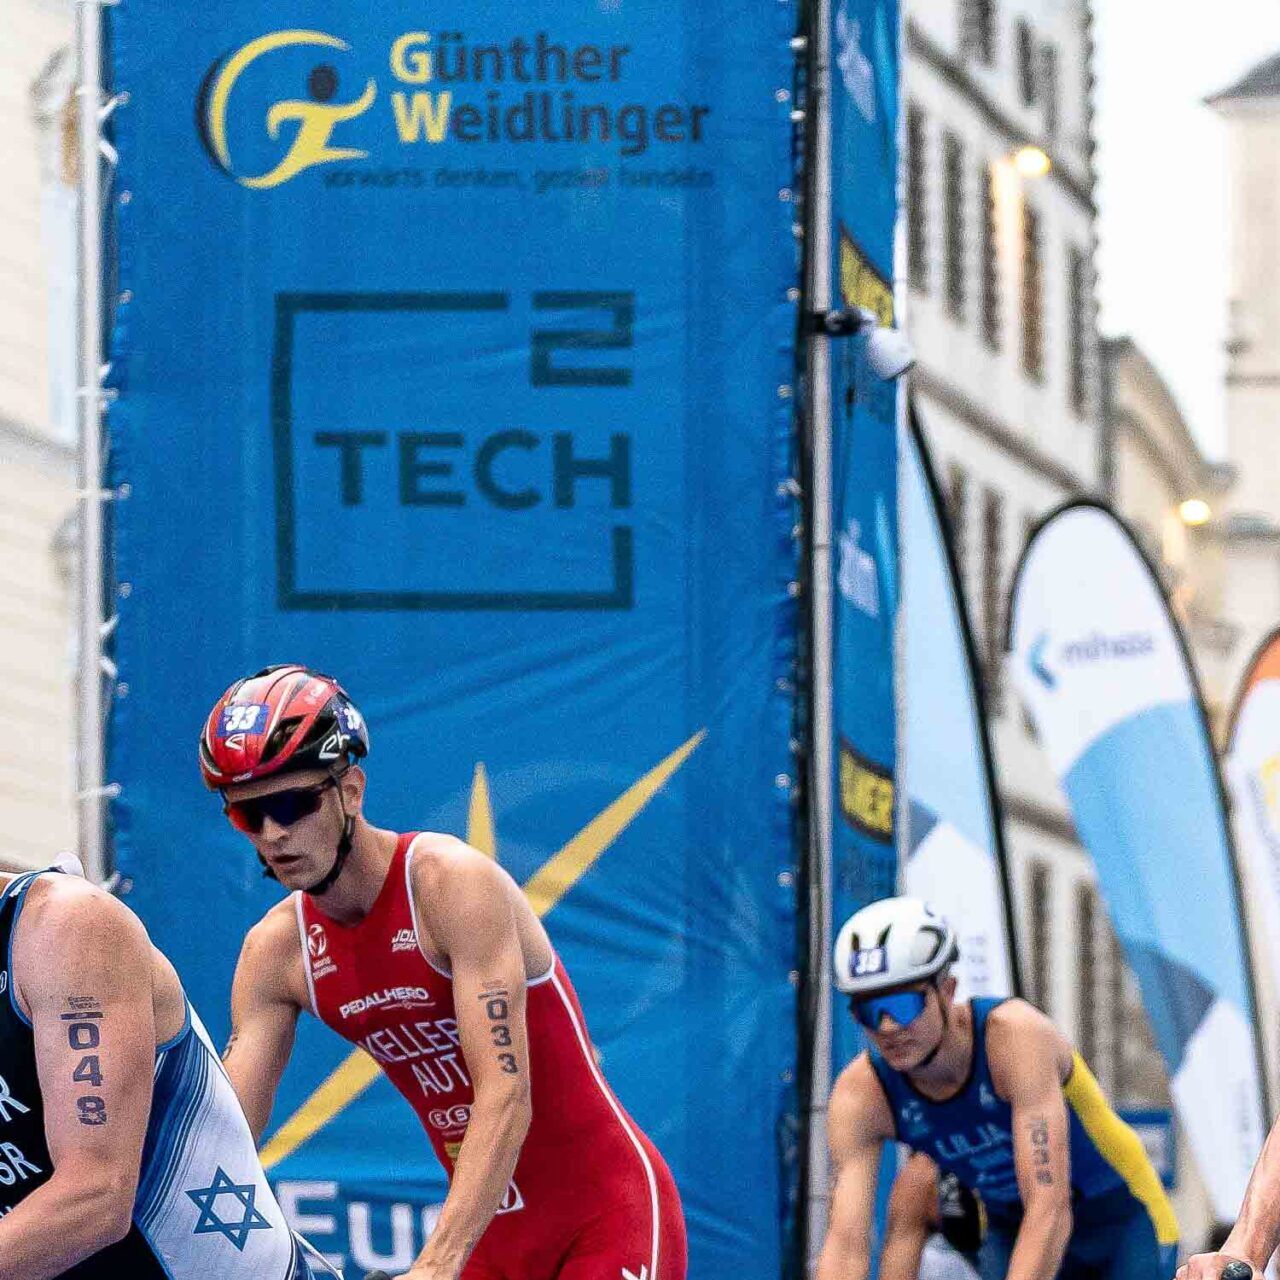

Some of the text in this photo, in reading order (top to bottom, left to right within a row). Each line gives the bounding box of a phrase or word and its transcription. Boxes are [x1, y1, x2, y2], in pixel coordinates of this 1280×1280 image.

[389, 30, 632, 84] Günther
[390, 89, 711, 157] Weidlinger
[313, 429, 631, 511] TECH
[339, 986, 430, 1019] PEDALHERO
[68, 1022, 108, 1126] 048
[411, 1052, 471, 1098] AUT
